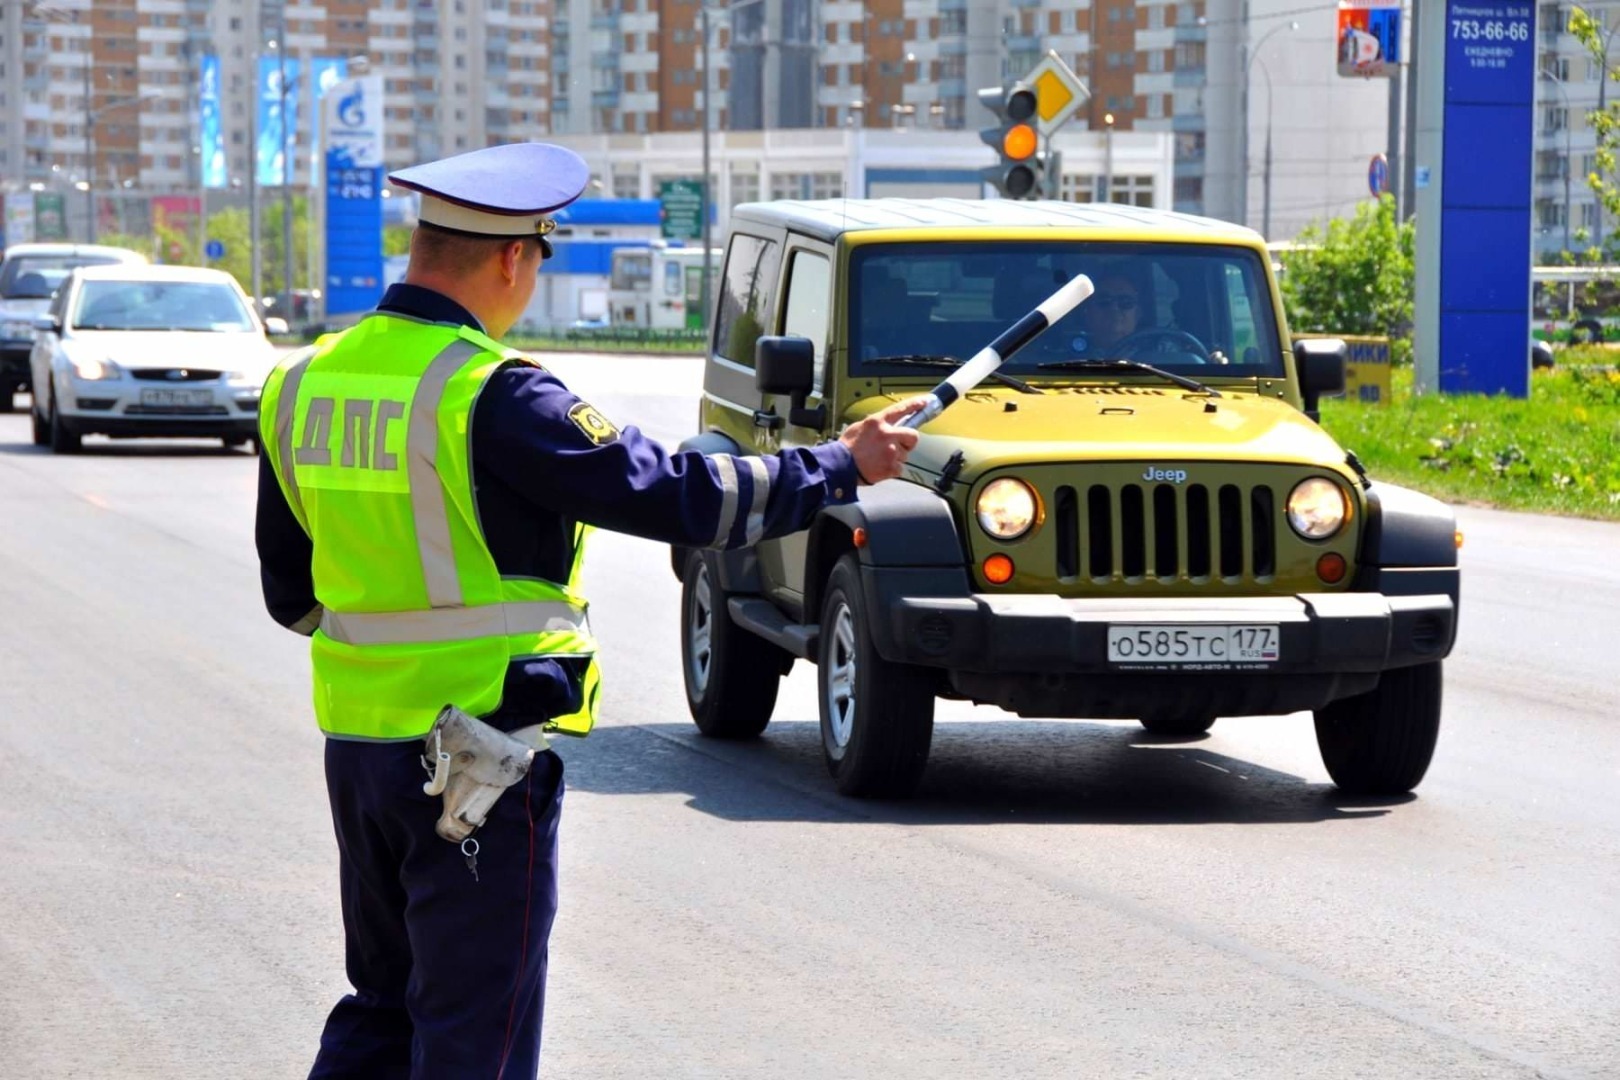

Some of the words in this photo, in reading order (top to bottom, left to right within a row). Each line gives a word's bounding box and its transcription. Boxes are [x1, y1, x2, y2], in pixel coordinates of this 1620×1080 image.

[1452, 20, 1528, 40] 753-66-66
[1464, 46, 1513, 57] ЕЖЕДНЕВНО
[294, 397, 406, 471] ДПС
[1142, 466, 1187, 484] Jeep
[1233, 628, 1272, 649] 177
[1240, 650, 1261, 658] RUS
